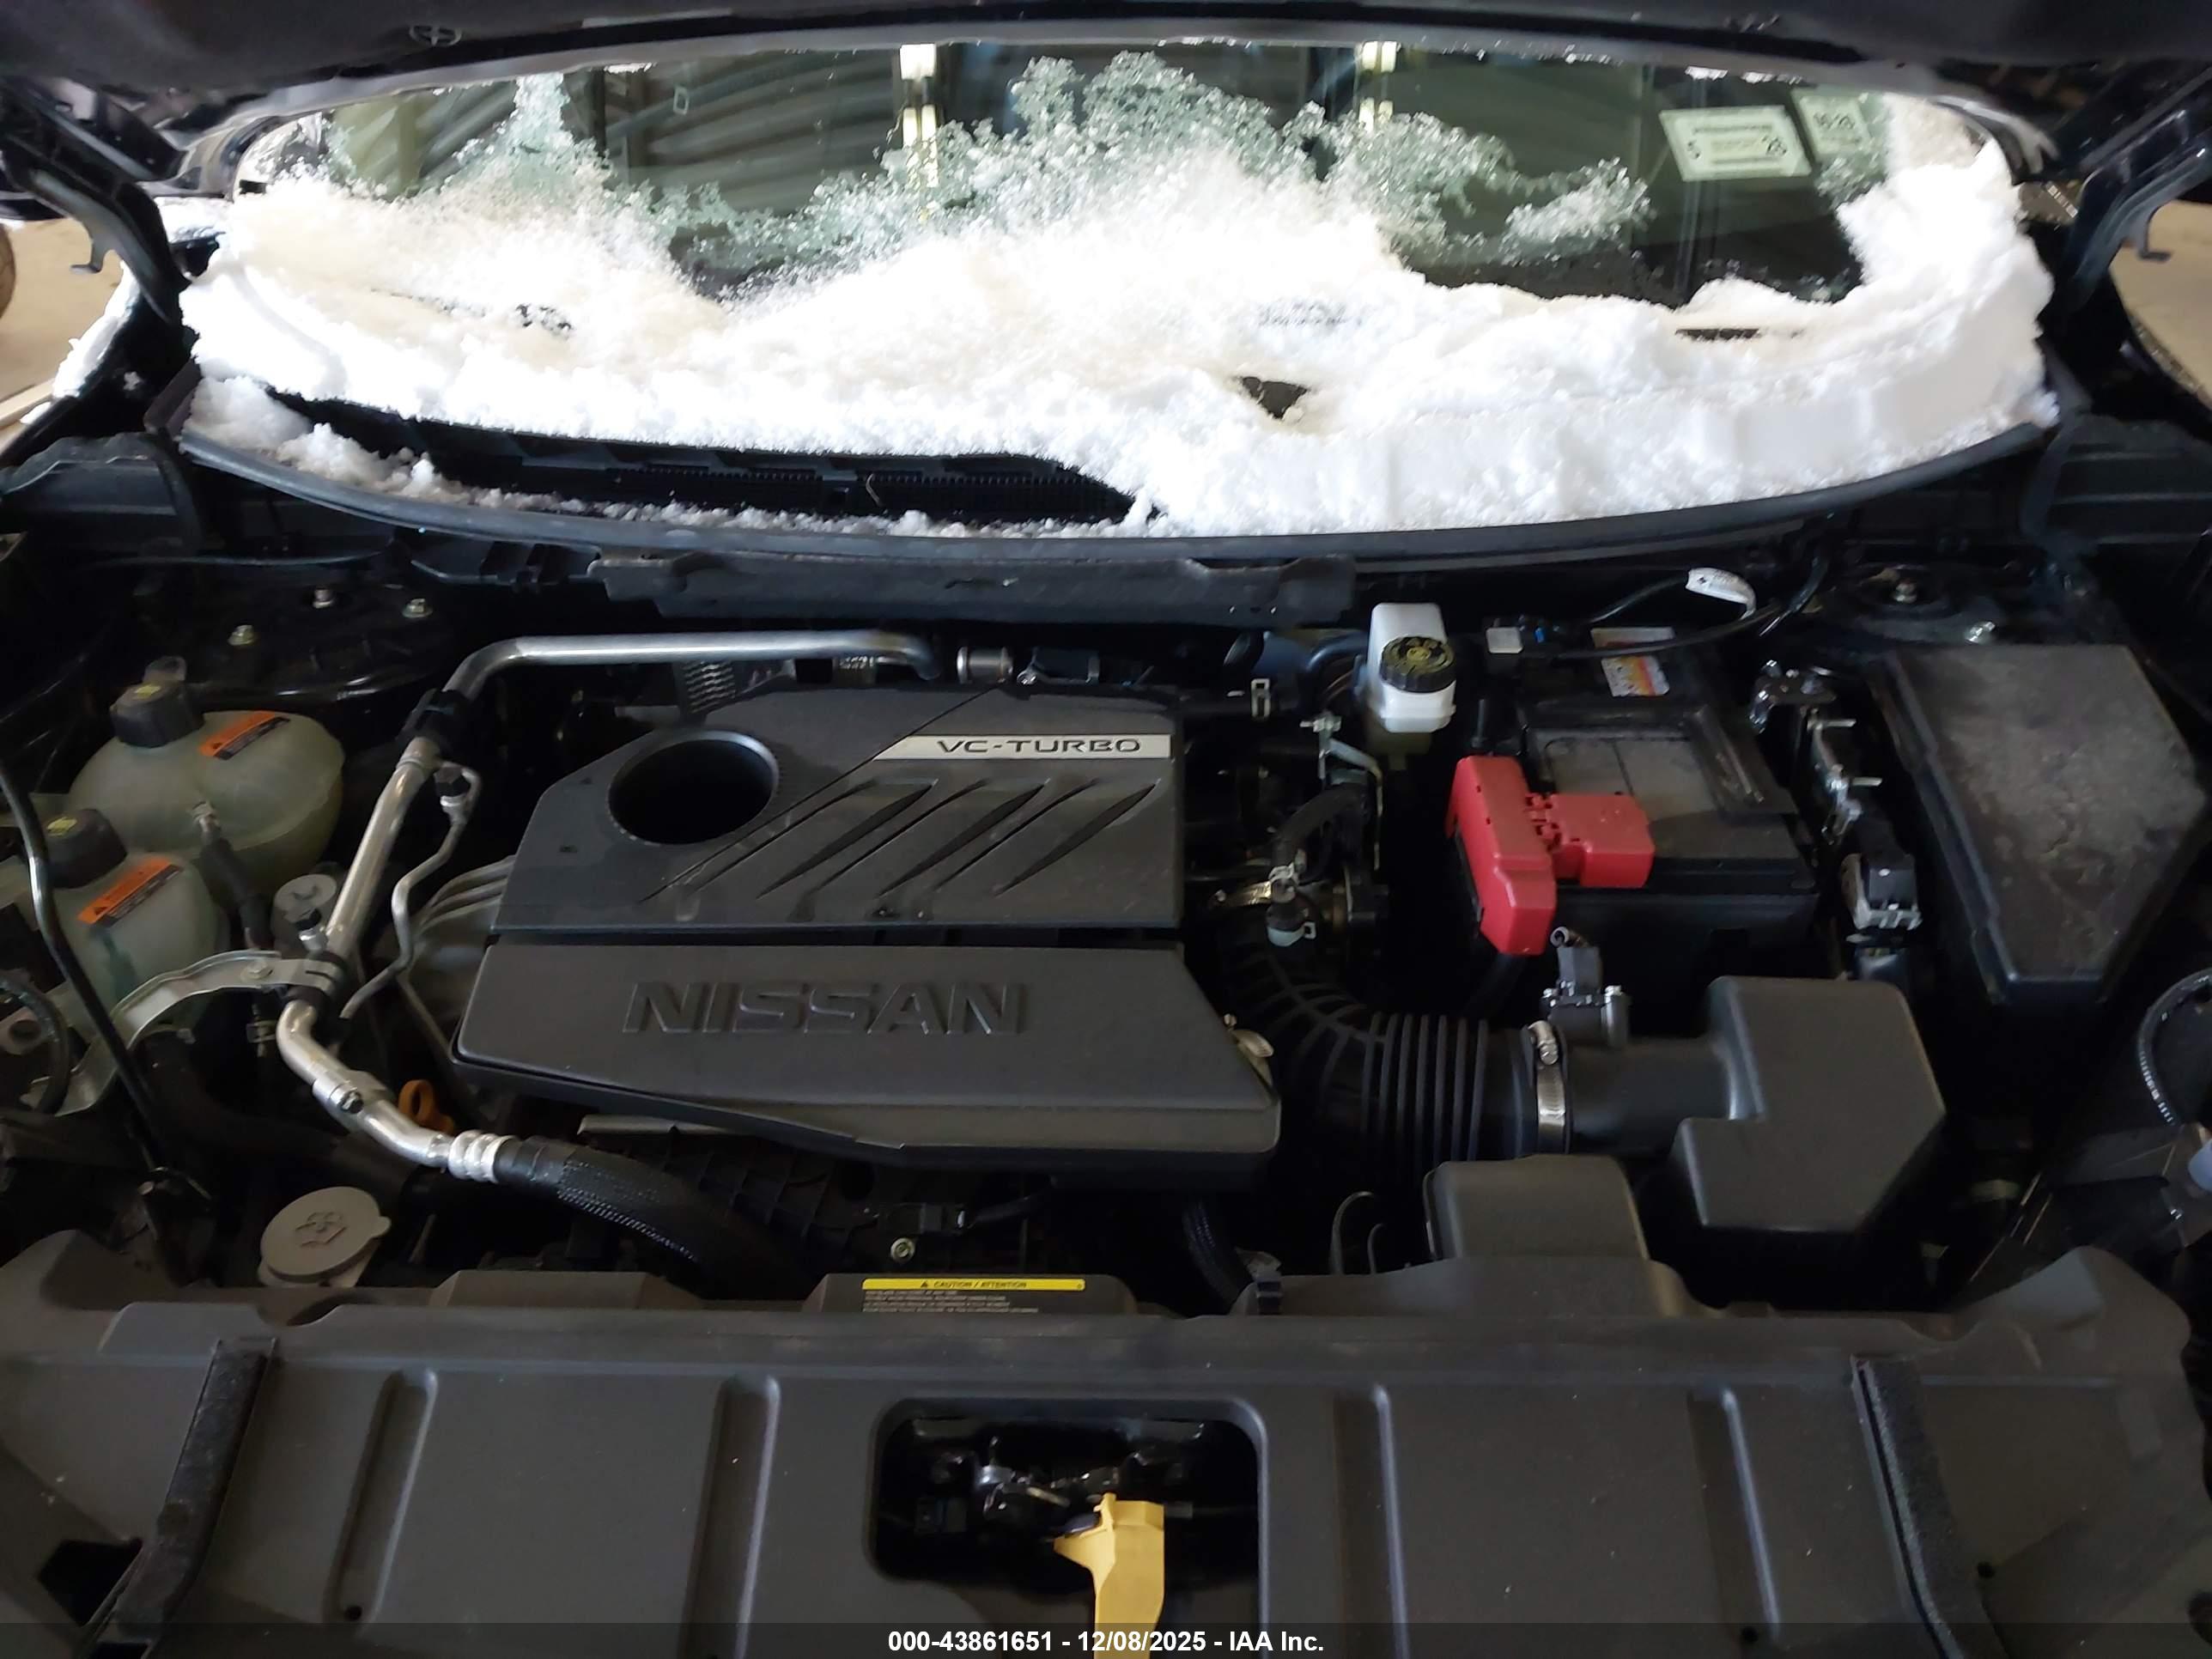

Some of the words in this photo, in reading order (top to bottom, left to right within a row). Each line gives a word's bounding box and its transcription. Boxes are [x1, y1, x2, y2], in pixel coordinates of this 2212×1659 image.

[937, 738, 1141, 754] VC-TURBO
[622, 981, 1021, 1036] NISSAN
[933, 1280, 972, 1289] CAUTION
[981, 1280, 1027, 1289] ATTENTION
